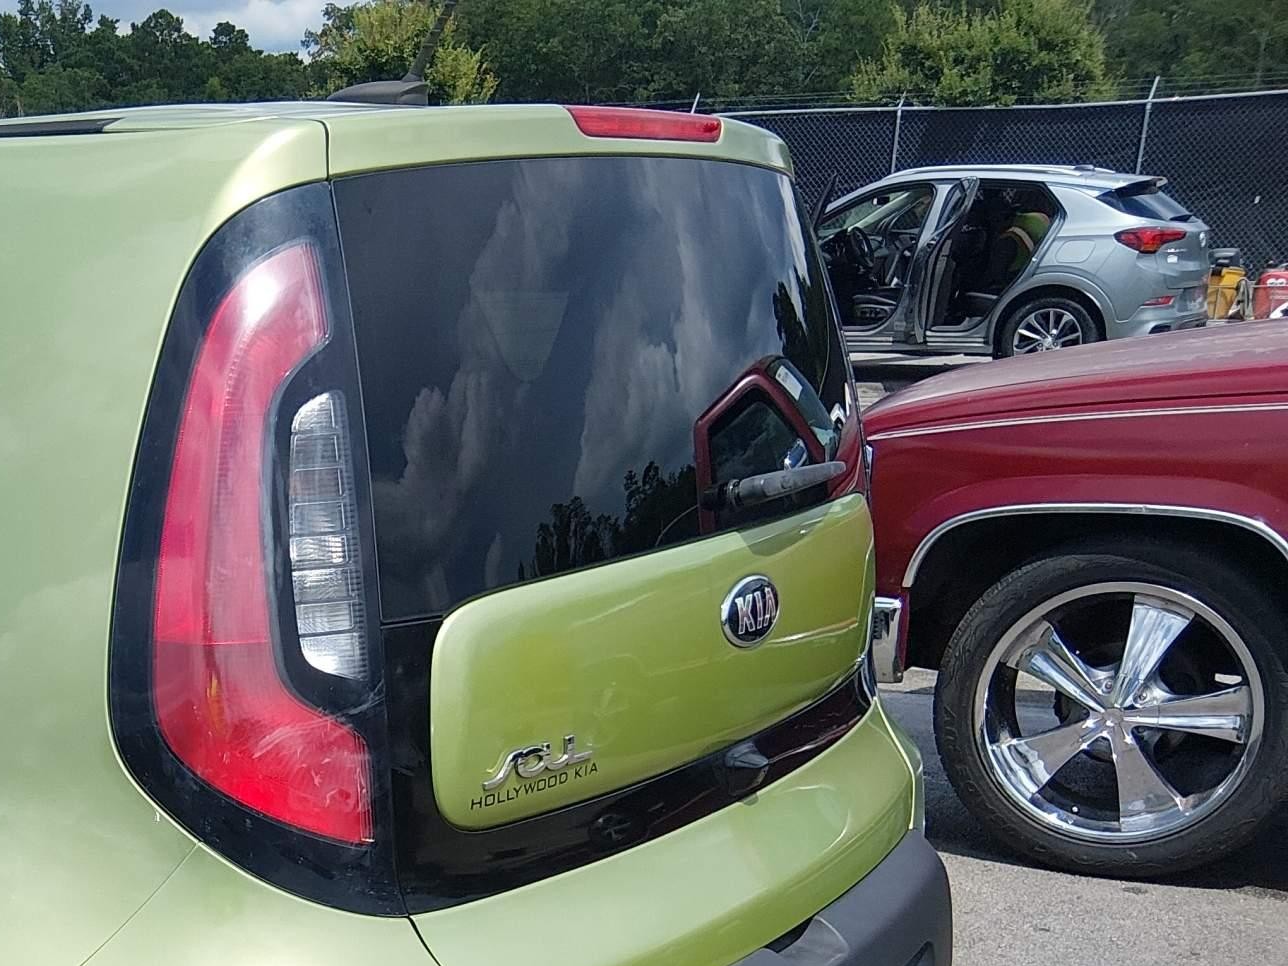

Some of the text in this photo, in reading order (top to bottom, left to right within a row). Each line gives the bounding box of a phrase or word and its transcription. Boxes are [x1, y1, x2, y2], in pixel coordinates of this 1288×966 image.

[734, 586, 777, 635] KIA
[470, 762, 599, 810] HOLLYWOOD KIA
